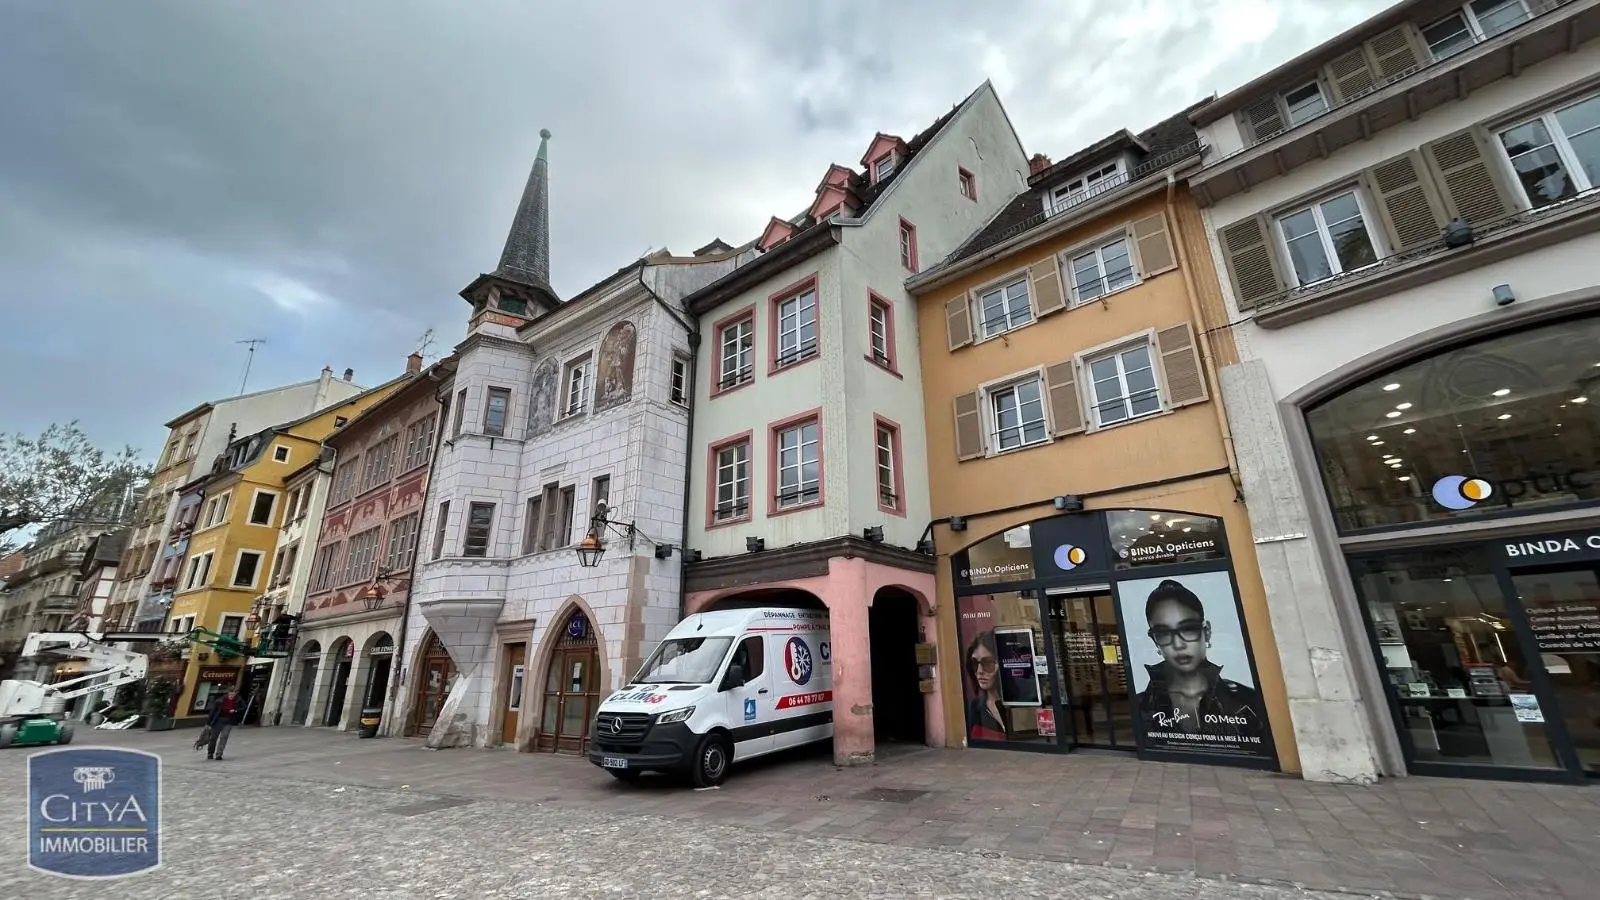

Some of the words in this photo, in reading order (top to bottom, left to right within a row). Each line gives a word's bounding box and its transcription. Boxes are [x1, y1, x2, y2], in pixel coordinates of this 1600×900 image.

[1131, 545, 1163, 556] BINDA
[1166, 540, 1215, 552] Opticiens
[1505, 538, 1580, 557] BINDA
[969, 566, 993, 576] BINDA
[994, 563, 1029, 574] Opticiens
[1152, 707, 1190, 728] Ray-Ban
[1219, 714, 1248, 725] Meta
[1147, 731, 1168, 739] NOUVEAU
[1169, 732, 1185, 740] DESIGN
[1186, 733, 1202, 741] CONÇU
[1250, 736, 1261, 744] VUE
